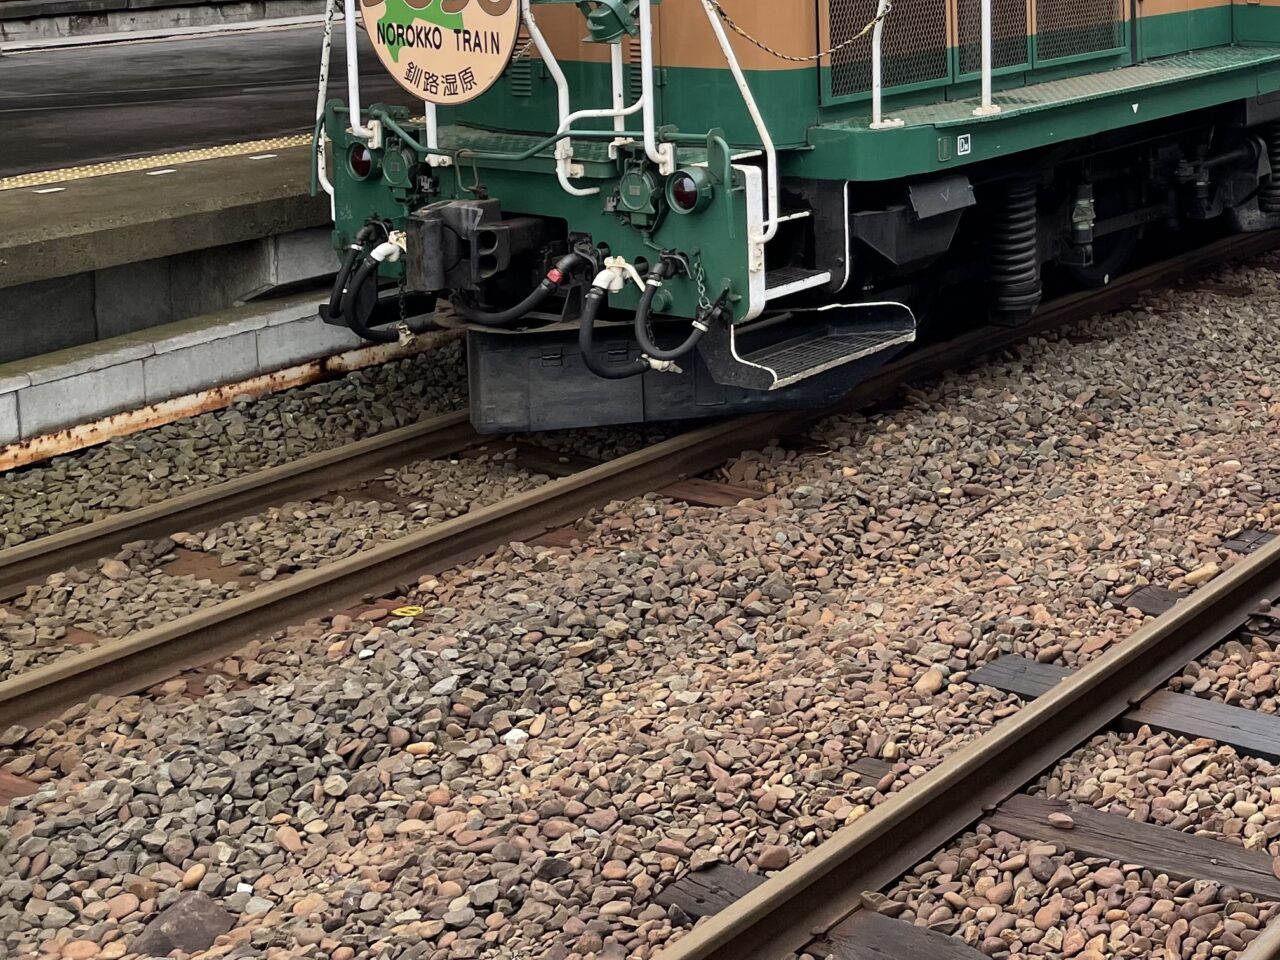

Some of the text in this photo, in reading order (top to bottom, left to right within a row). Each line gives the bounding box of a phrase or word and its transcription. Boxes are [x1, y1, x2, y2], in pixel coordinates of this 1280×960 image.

[377, 22, 500, 55] NOROKKO TRAIN
[404, 61, 477, 96] 釧路湿原
